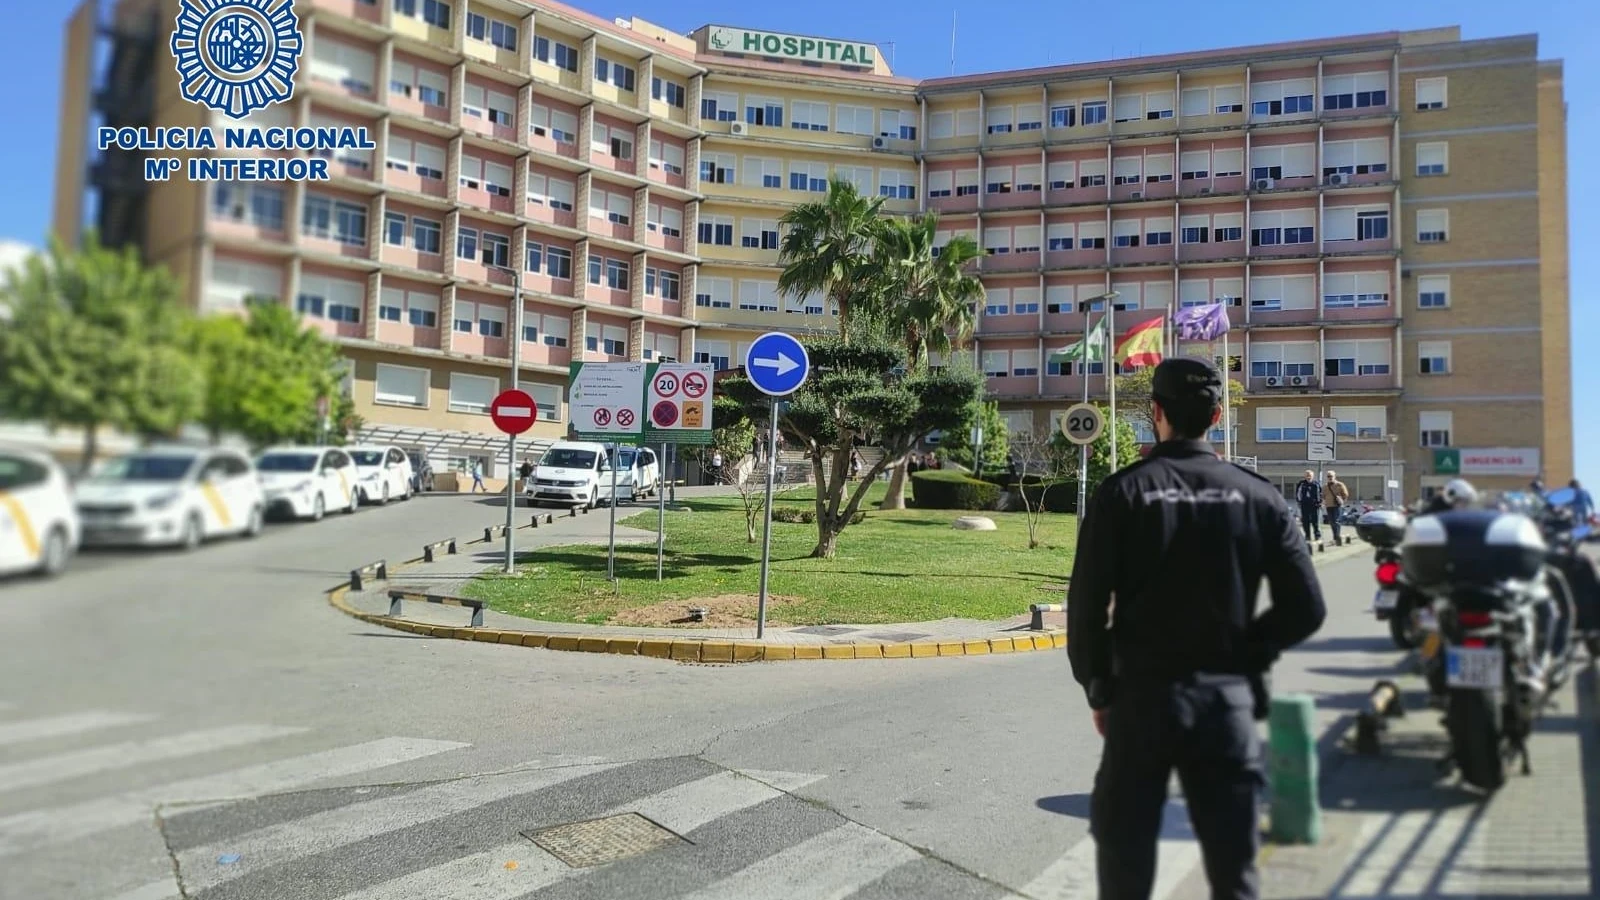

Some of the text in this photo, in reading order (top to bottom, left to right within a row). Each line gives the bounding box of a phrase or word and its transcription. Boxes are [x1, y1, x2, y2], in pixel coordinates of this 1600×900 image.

[743, 32, 873, 64] HOSPITAL
[659, 379, 674, 391] 20
[1069, 417, 1094, 431] 20
[1463, 455, 1524, 466] URGENCIAS
[1143, 487, 1246, 506] POLICIA
